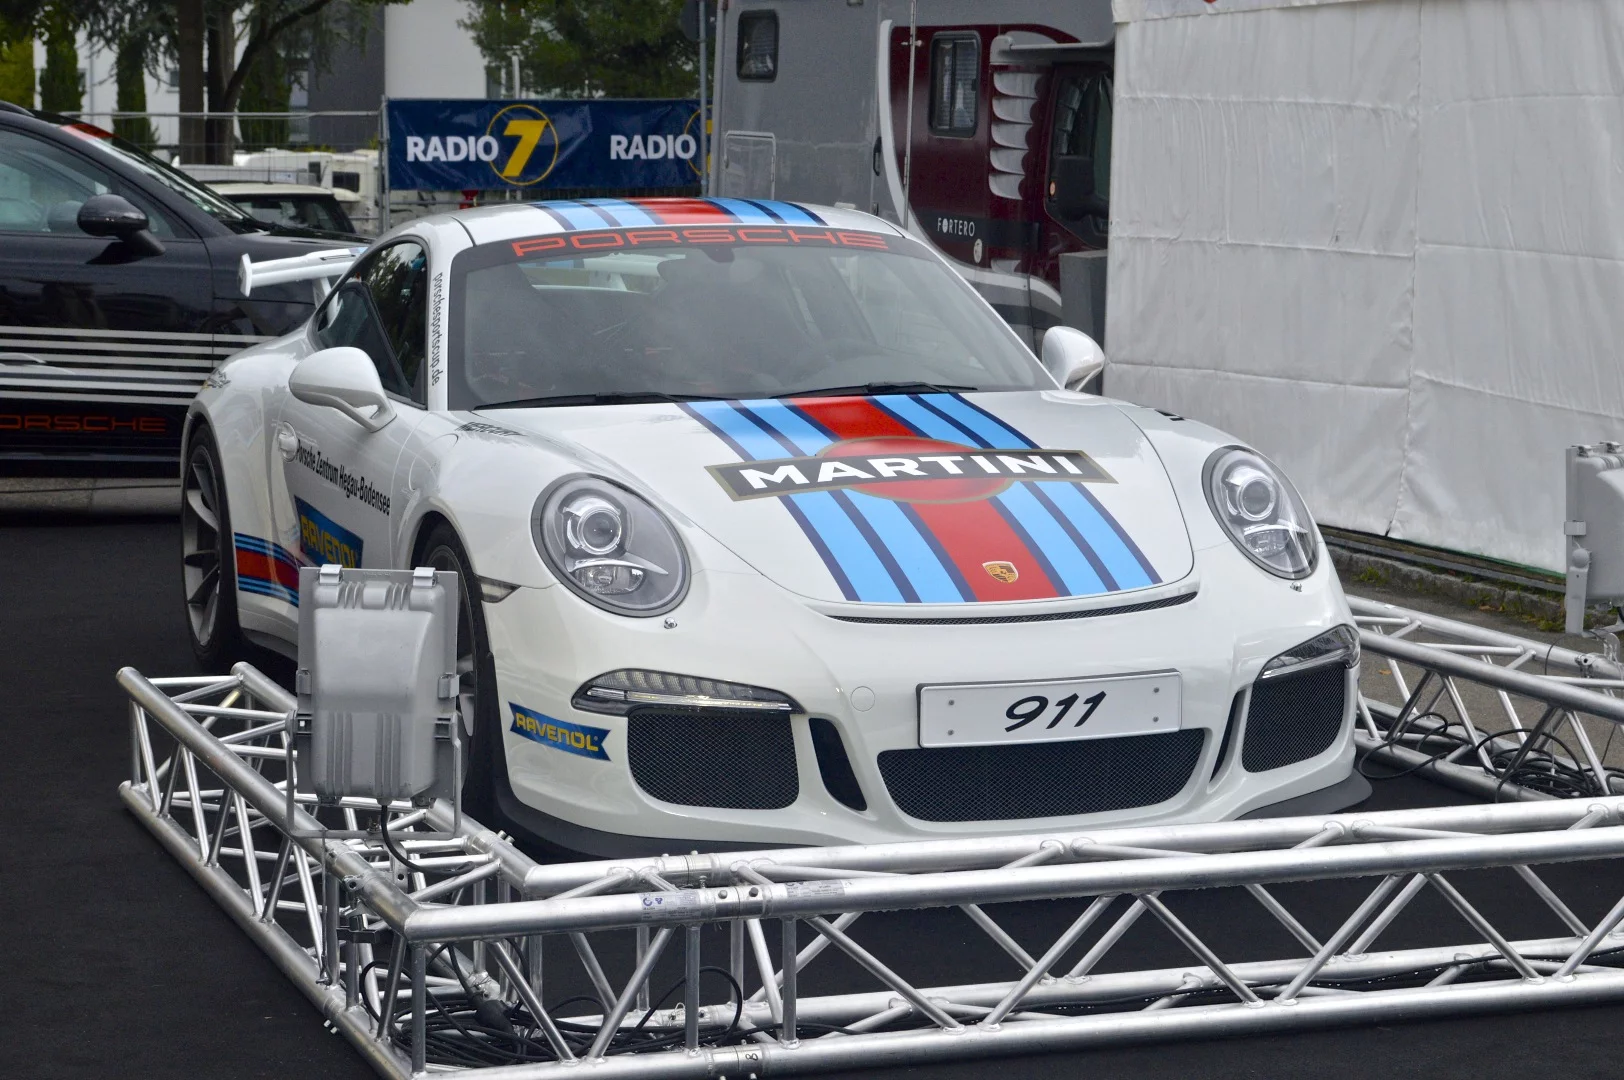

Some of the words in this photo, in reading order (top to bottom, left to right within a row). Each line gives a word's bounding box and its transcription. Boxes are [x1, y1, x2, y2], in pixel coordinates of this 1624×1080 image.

[406, 135, 500, 162] RADIO
[503, 119, 550, 177] 7
[610, 134, 698, 160] RADIO
[511, 228, 889, 257] PORSCHE
[937, 217, 976, 237] FORTERO
[429, 272, 446, 387] porschesportscup.de
[0, 414, 167, 432] ORSCHE
[315, 450, 339, 486] Zentrum
[339, 464, 391, 516] Hegau-Bodensee
[739, 455, 1084, 489] MARTINI
[1004, 691, 1107, 733] 911
[515, 713, 599, 751] RAVENOL
